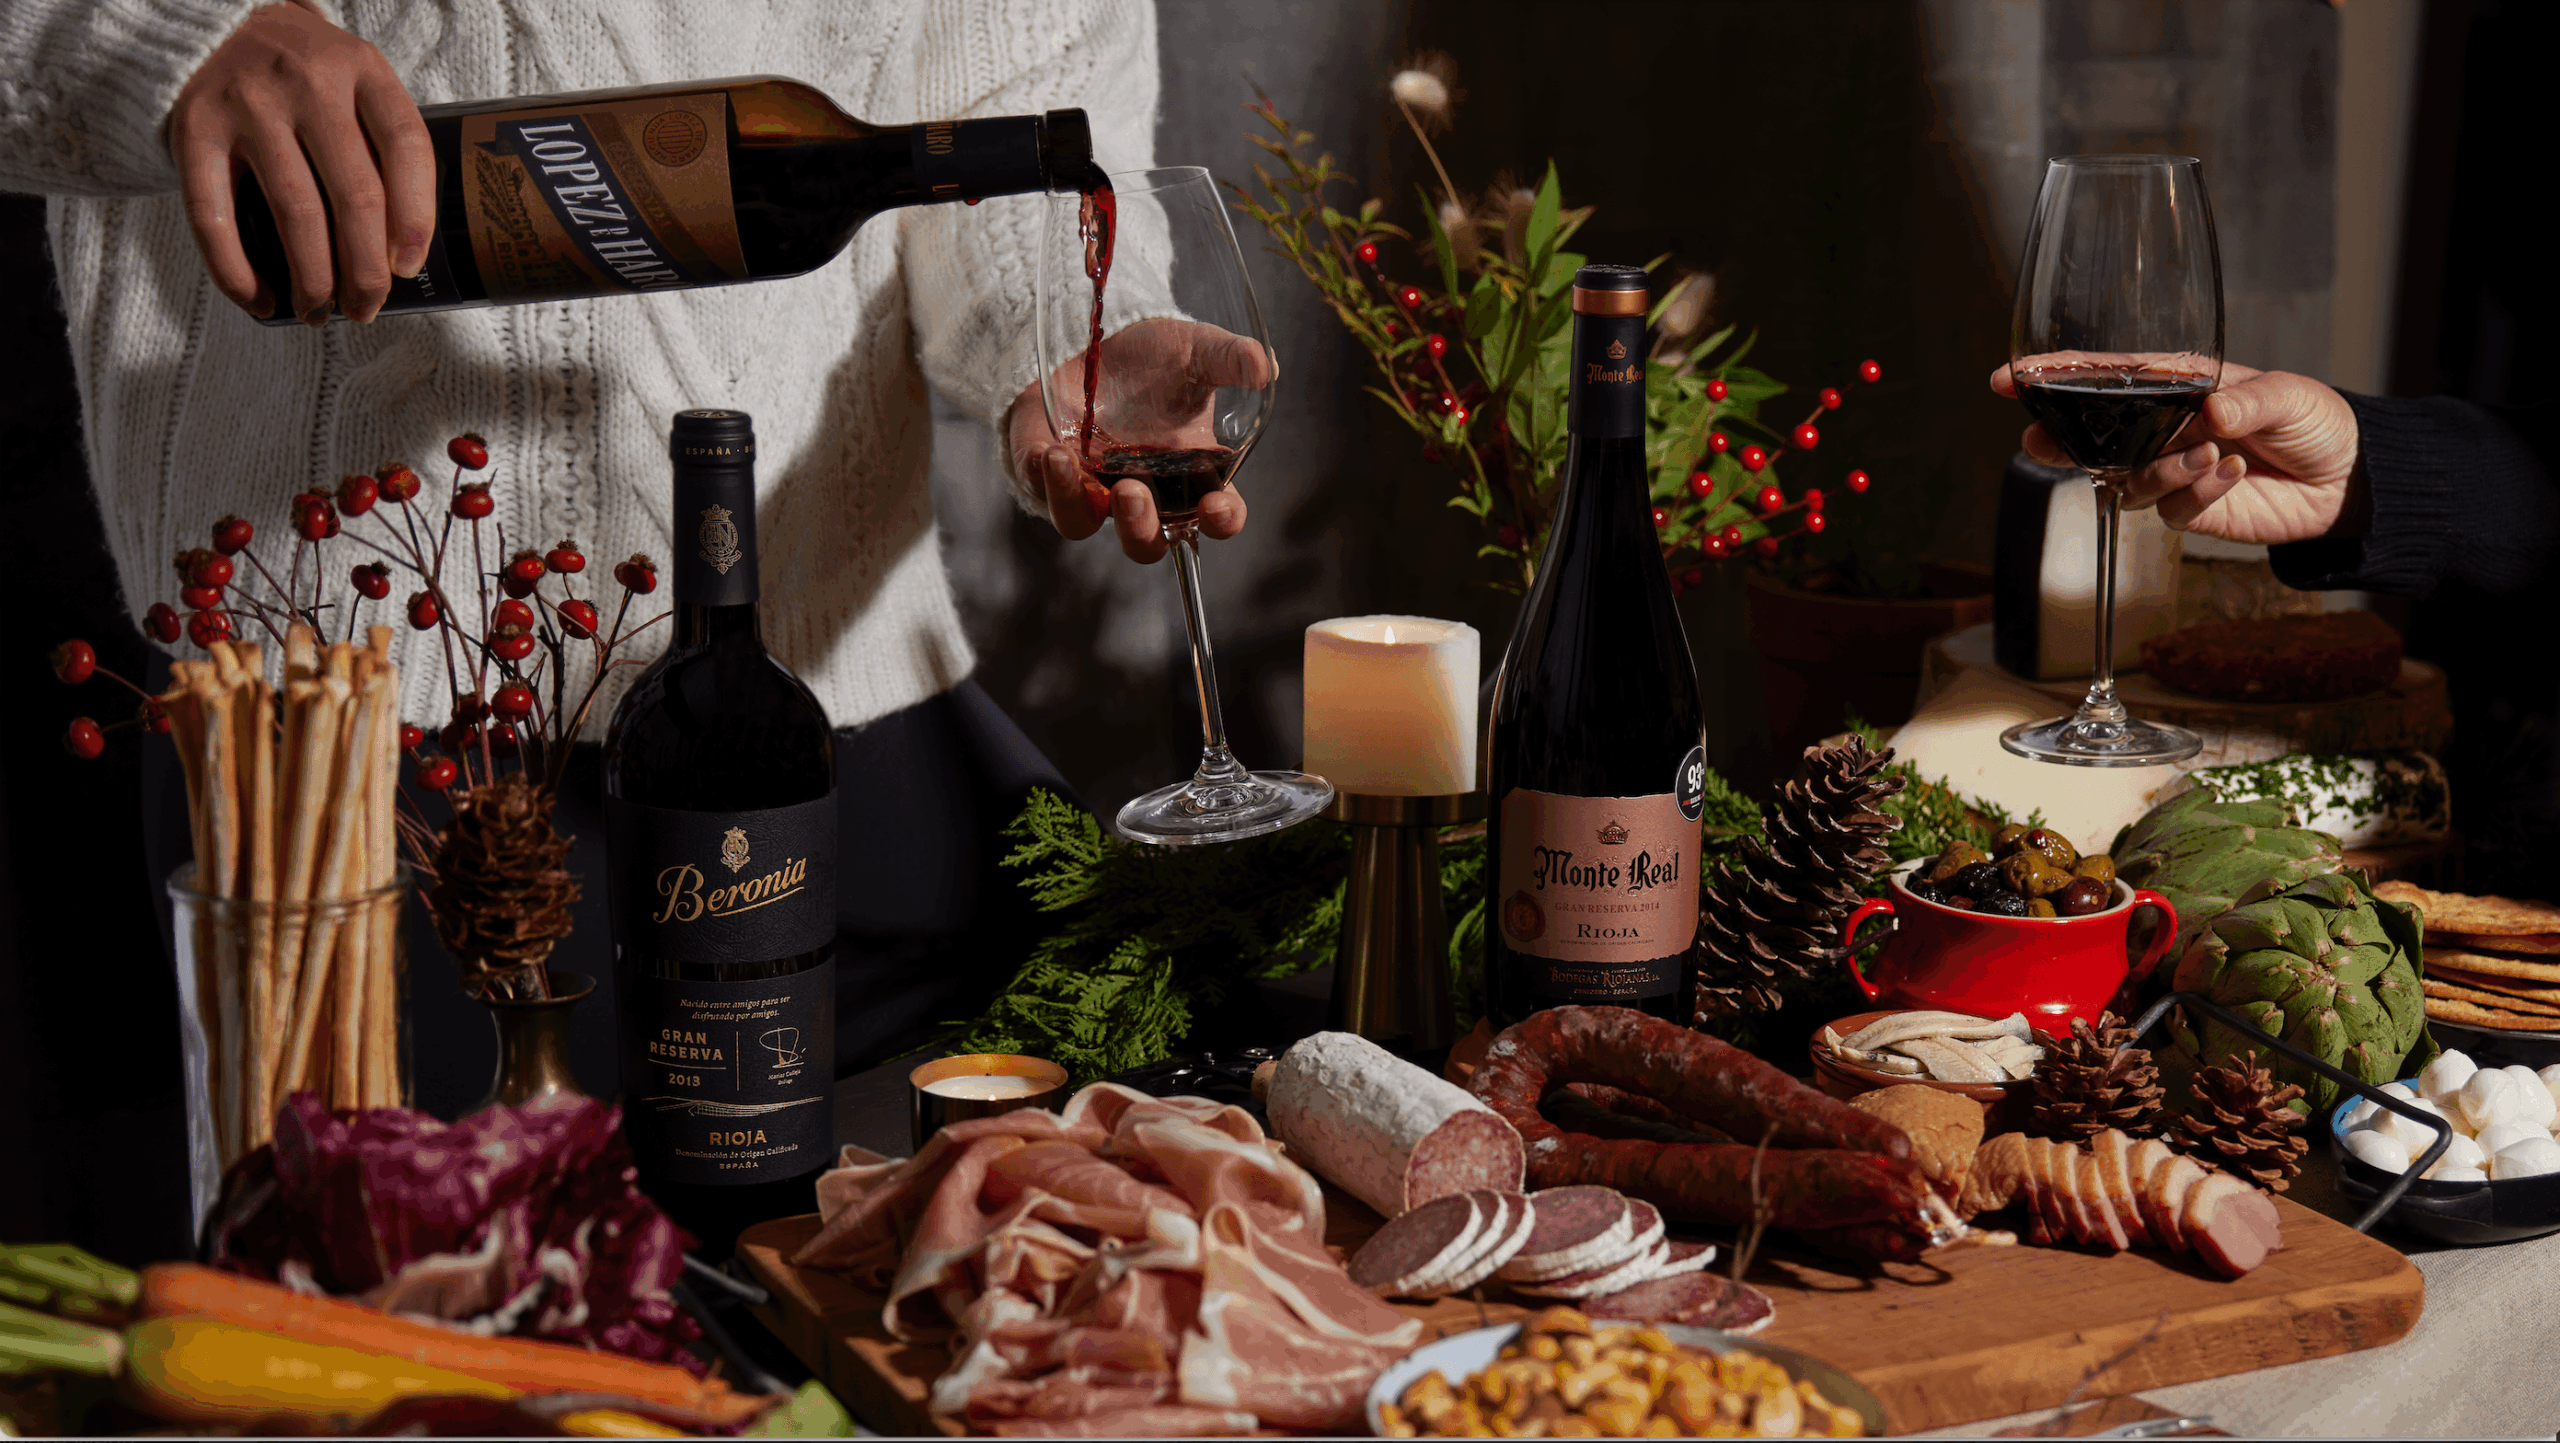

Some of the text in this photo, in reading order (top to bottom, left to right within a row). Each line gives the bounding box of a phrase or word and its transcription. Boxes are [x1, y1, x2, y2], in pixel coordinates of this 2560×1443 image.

[926, 122, 954, 154] HARO
[519, 122, 629, 225] LOPEZ
[1586, 362, 1624, 385] Monte
[686, 446, 731, 456] ESPAÑA
[1687, 761, 1702, 794] 93
[1533, 845, 1680, 893] Monte Real
[652, 857, 807, 924] Beronia
[1555, 902, 1660, 915] GRAN RESERVA 2014
[1549, 966, 1598, 984] BODEGAS
[1612, 987, 1638, 995] ESPAÑA
[679, 996, 791, 1010] Nacido entre amigos para ser
[692, 1008, 780, 1022] disfrutado por amigos.
[661, 1028, 707, 1045] GRAN
[650, 1041, 723, 1061] RESERVA
[668, 1072, 701, 1087] 2013
[709, 1129, 768, 1147] RIOJA
[675, 1142, 799, 1159] Denominación de Origen Calificada
[719, 1161, 759, 1170] ESPAÑA
